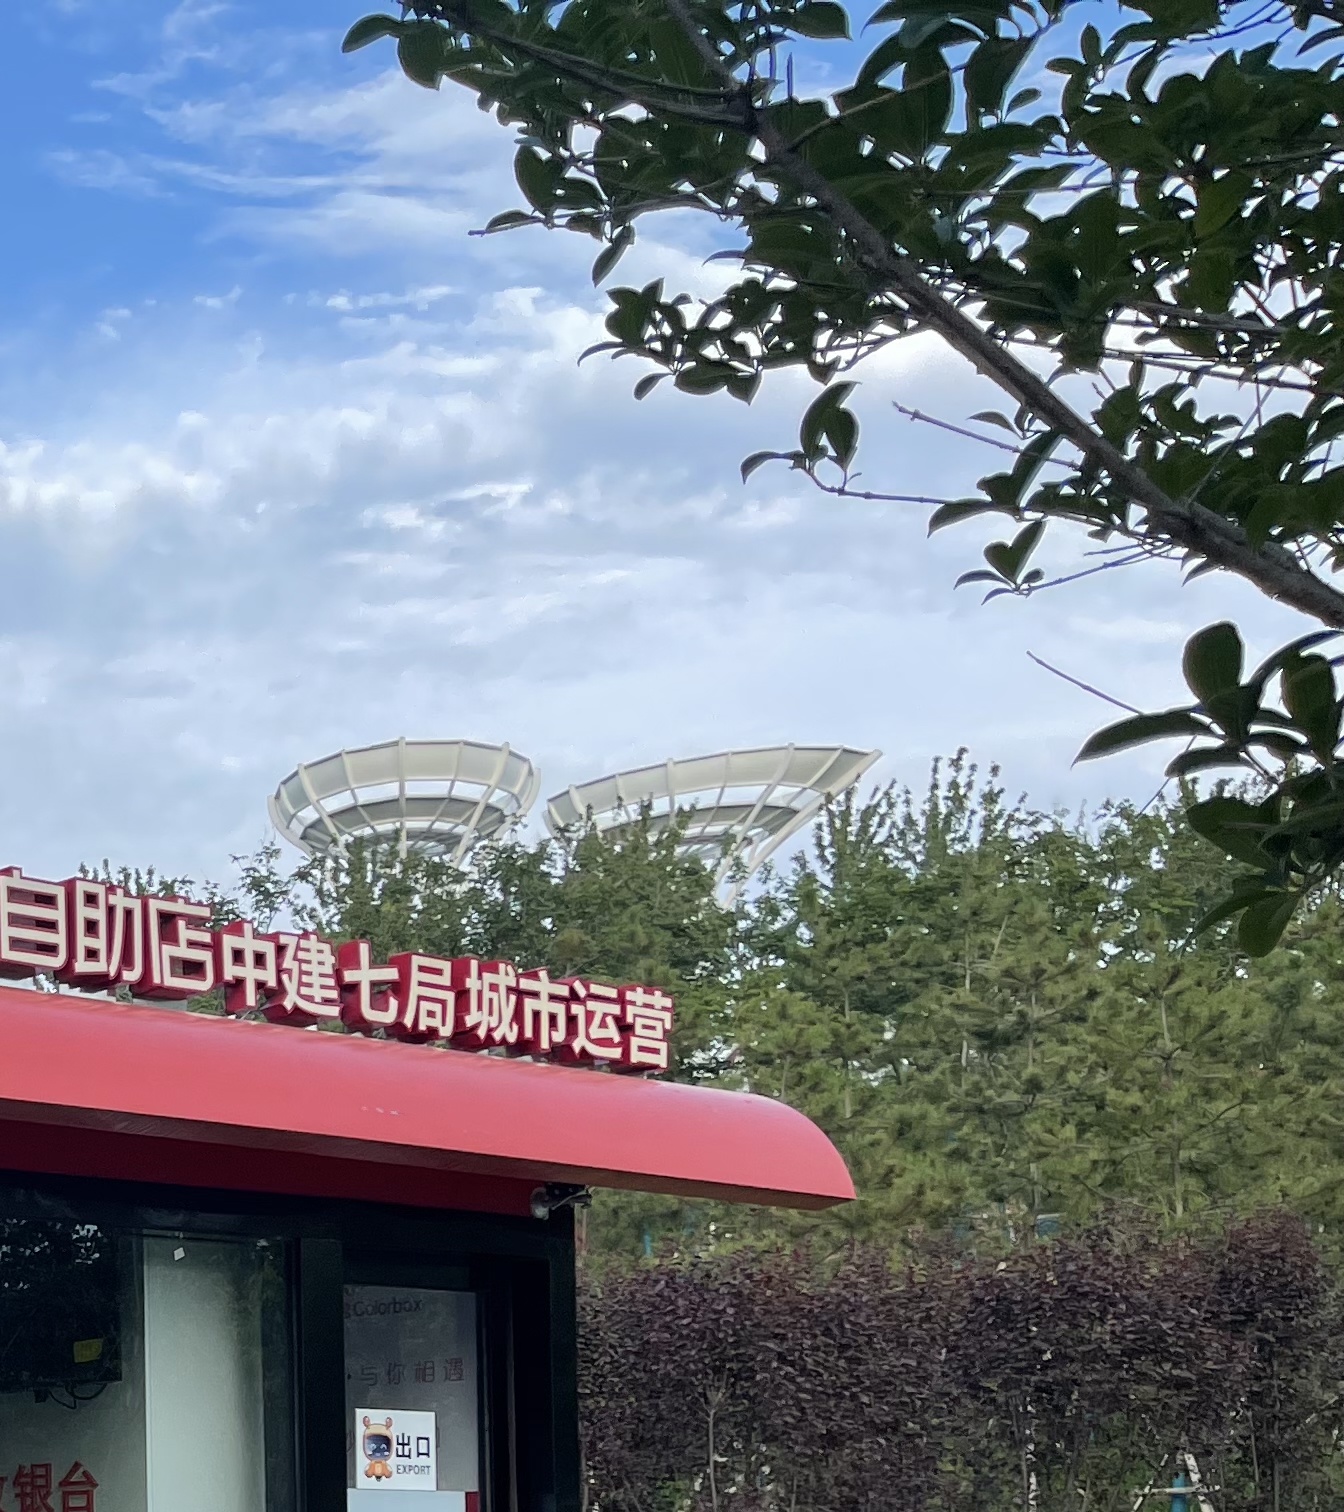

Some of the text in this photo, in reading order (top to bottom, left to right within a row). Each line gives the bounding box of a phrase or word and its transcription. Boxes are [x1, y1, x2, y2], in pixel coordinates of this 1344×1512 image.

[360, 1357, 465, 1386] 与你相遇
[395, 1432, 431, 1459] 出口
[395, 1464, 431, 1476] EXPORT
